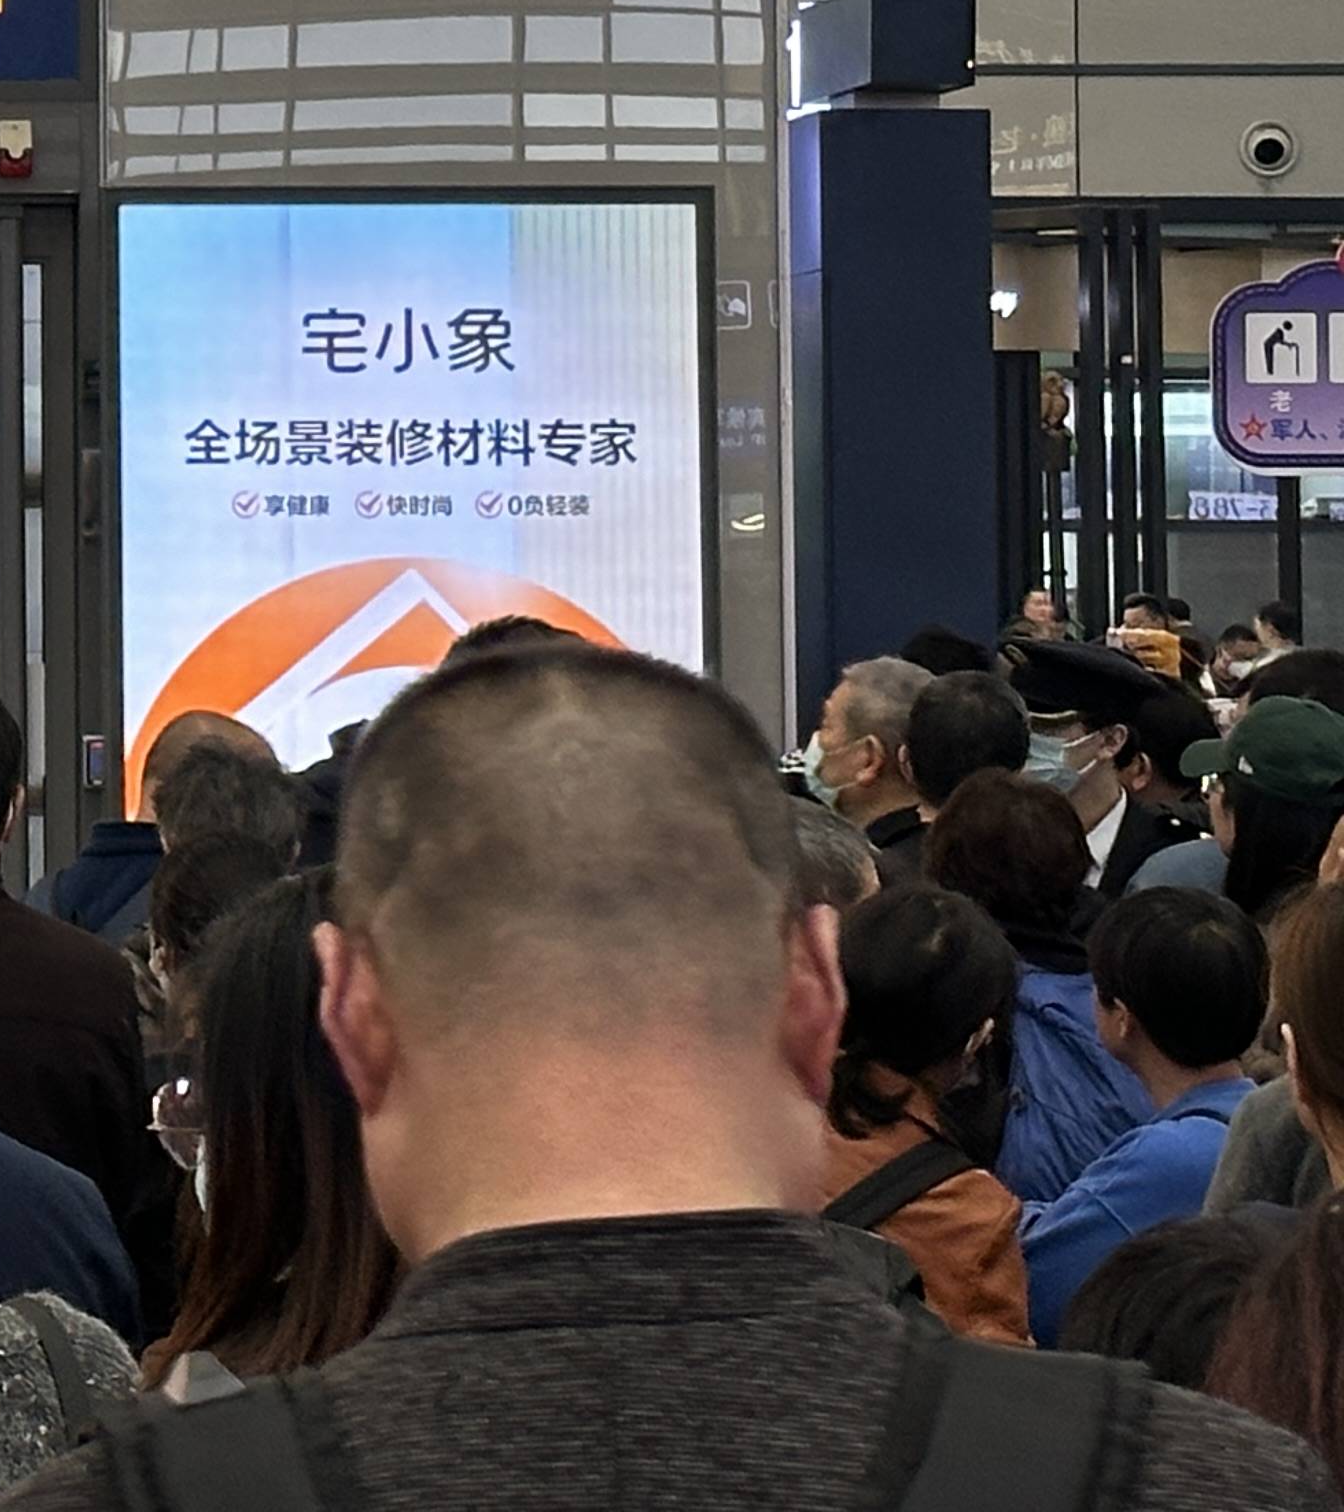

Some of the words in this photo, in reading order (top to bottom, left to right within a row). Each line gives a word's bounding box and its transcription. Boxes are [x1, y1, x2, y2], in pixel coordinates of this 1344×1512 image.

[303, 308, 516, 375] 宅小象
[1269, 390, 1293, 412] 老
[186, 419, 638, 468] 全场景装修材料专家
[266, 495, 331, 518] 享健康
[387, 496, 454, 518] 快时尚
[508, 495, 591, 517] 0负轻装
